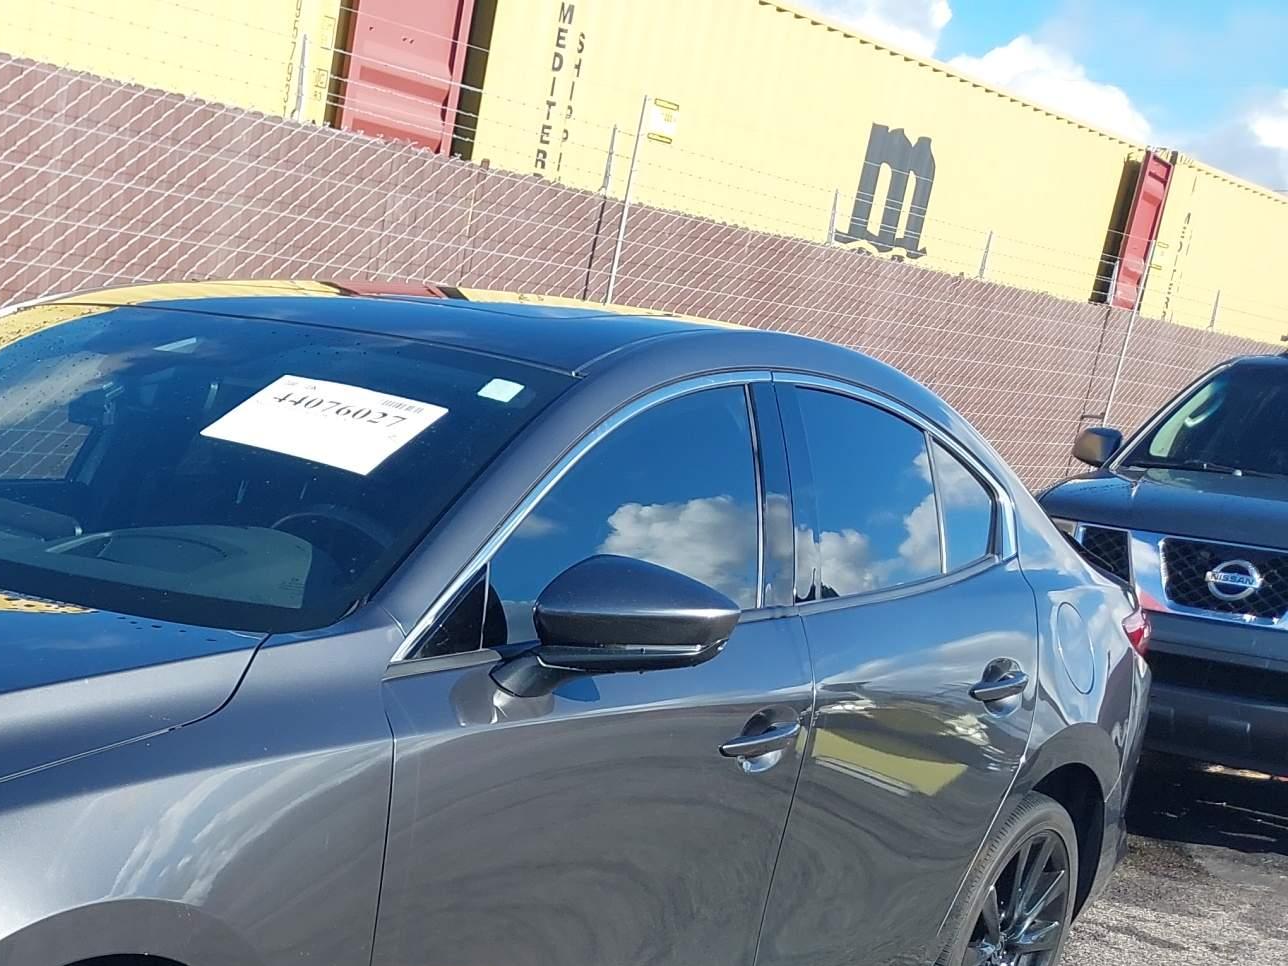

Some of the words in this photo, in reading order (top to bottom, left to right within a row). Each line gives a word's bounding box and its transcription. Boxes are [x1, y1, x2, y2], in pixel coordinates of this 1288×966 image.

[532, 2, 575, 178] MEDITER
[273, 392, 408, 427] 44076027
[1210, 572, 1254, 585] NISSAN
